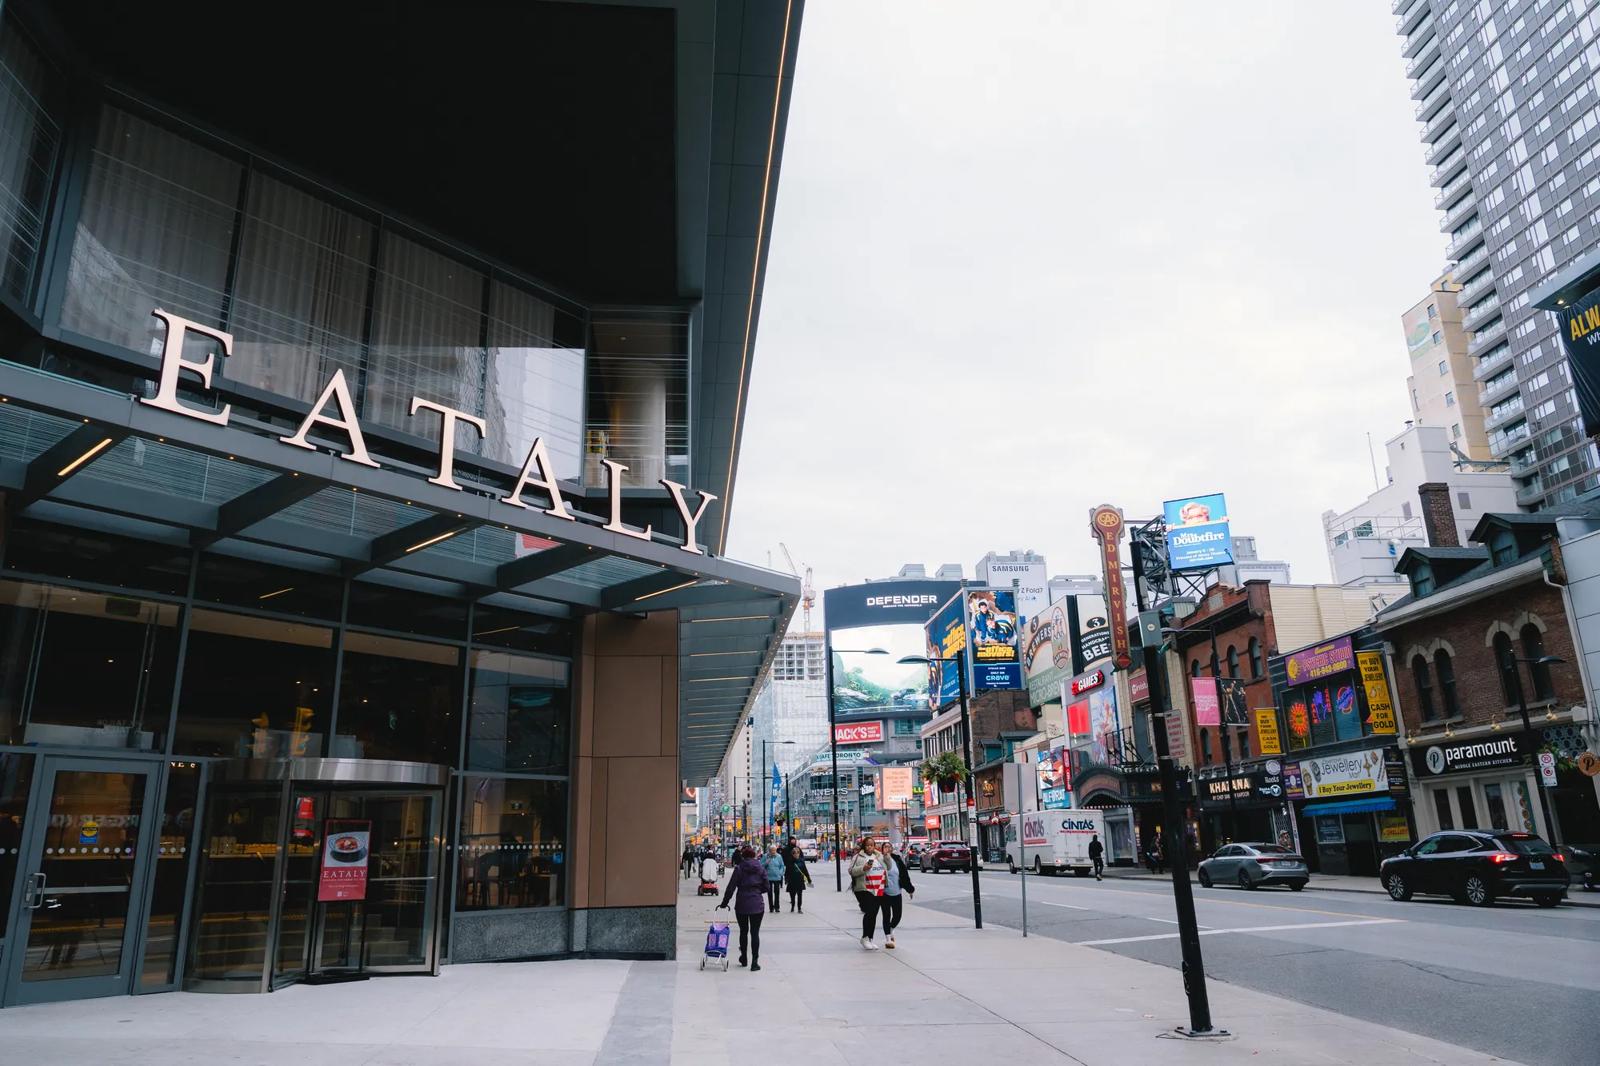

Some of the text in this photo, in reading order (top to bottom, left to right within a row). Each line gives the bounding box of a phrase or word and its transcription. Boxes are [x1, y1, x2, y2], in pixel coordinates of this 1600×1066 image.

[140, 308, 717, 554] EATALY
[1173, 532, 1225, 546] Doubtfire
[1106, 531, 1126, 649] ED MIRVISH
[866, 595, 938, 606] DEFENDER
[1082, 643, 1111, 661] BEE
[1078, 672, 1099, 691] GAMES
[1374, 721, 1394, 729] GOLD
[1445, 737, 1518, 765] paramount
[1346, 782, 1372, 790] Jewellery
[1024, 817, 1044, 838] CINTAS
[1062, 818, 1094, 830] CINTAS
[323, 870, 365, 878] EATALY
